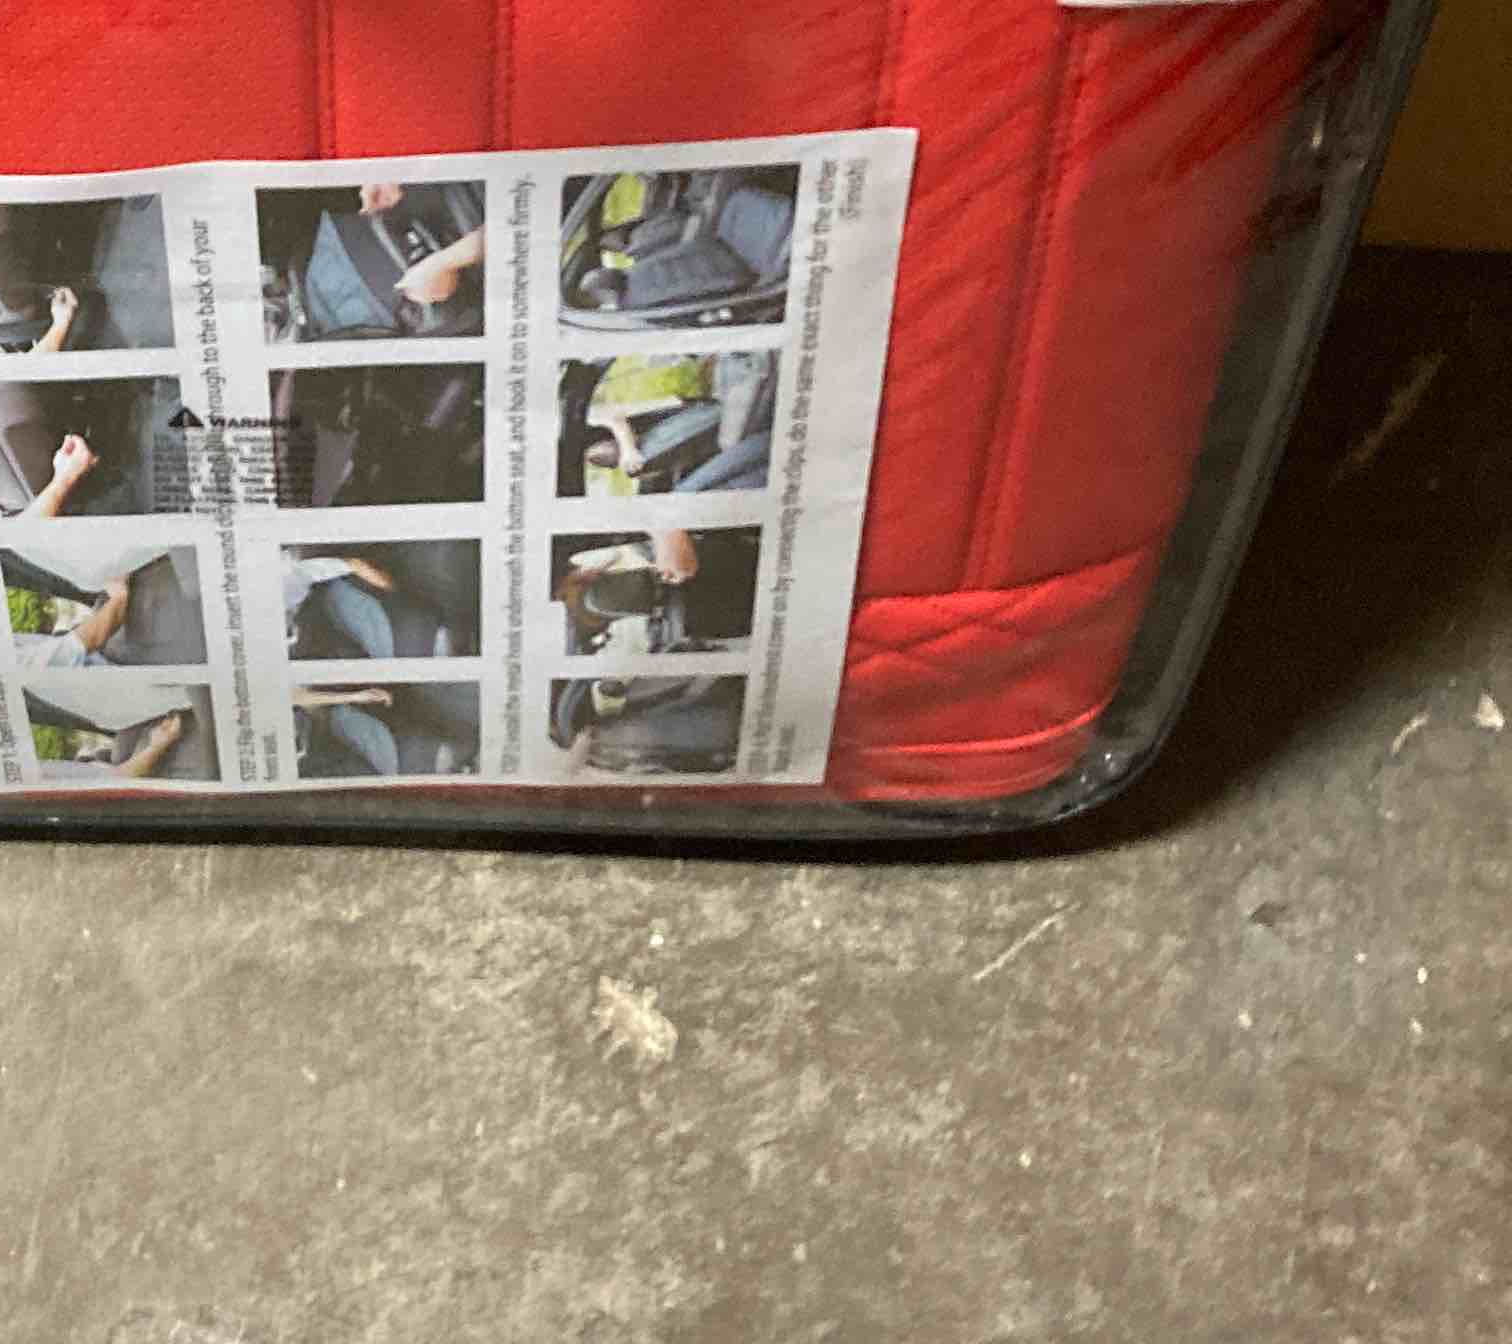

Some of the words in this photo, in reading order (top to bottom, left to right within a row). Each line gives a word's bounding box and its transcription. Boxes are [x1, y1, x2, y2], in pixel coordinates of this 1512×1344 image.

[816, 160, 837, 203] other
[810, 207, 832, 234] the
[192, 219, 214, 255] your
[805, 239, 827, 261] for
[189, 258, 211, 275] of
[509, 230, 529, 318] somewhere
[193, 279, 214, 315] back
[804, 265, 831, 307] thing
[197, 319, 216, 344] the
[509, 322, 528, 339] to
[203, 347, 218, 363] to
[511, 341, 527, 361] on
[509, 364, 526, 374] it
[796, 355, 814, 393] same
[508, 378, 525, 411] hook
[790, 392, 810, 419] the
[507, 415, 525, 443] and
[786, 422, 807, 442] do
[506, 480, 524, 530] bottom
[216, 530, 236, 569] round
[504, 534, 524, 554] the
[221, 572, 238, 592] the
[505, 558, 522, 627] underneath
[225, 596, 241, 629] insert
